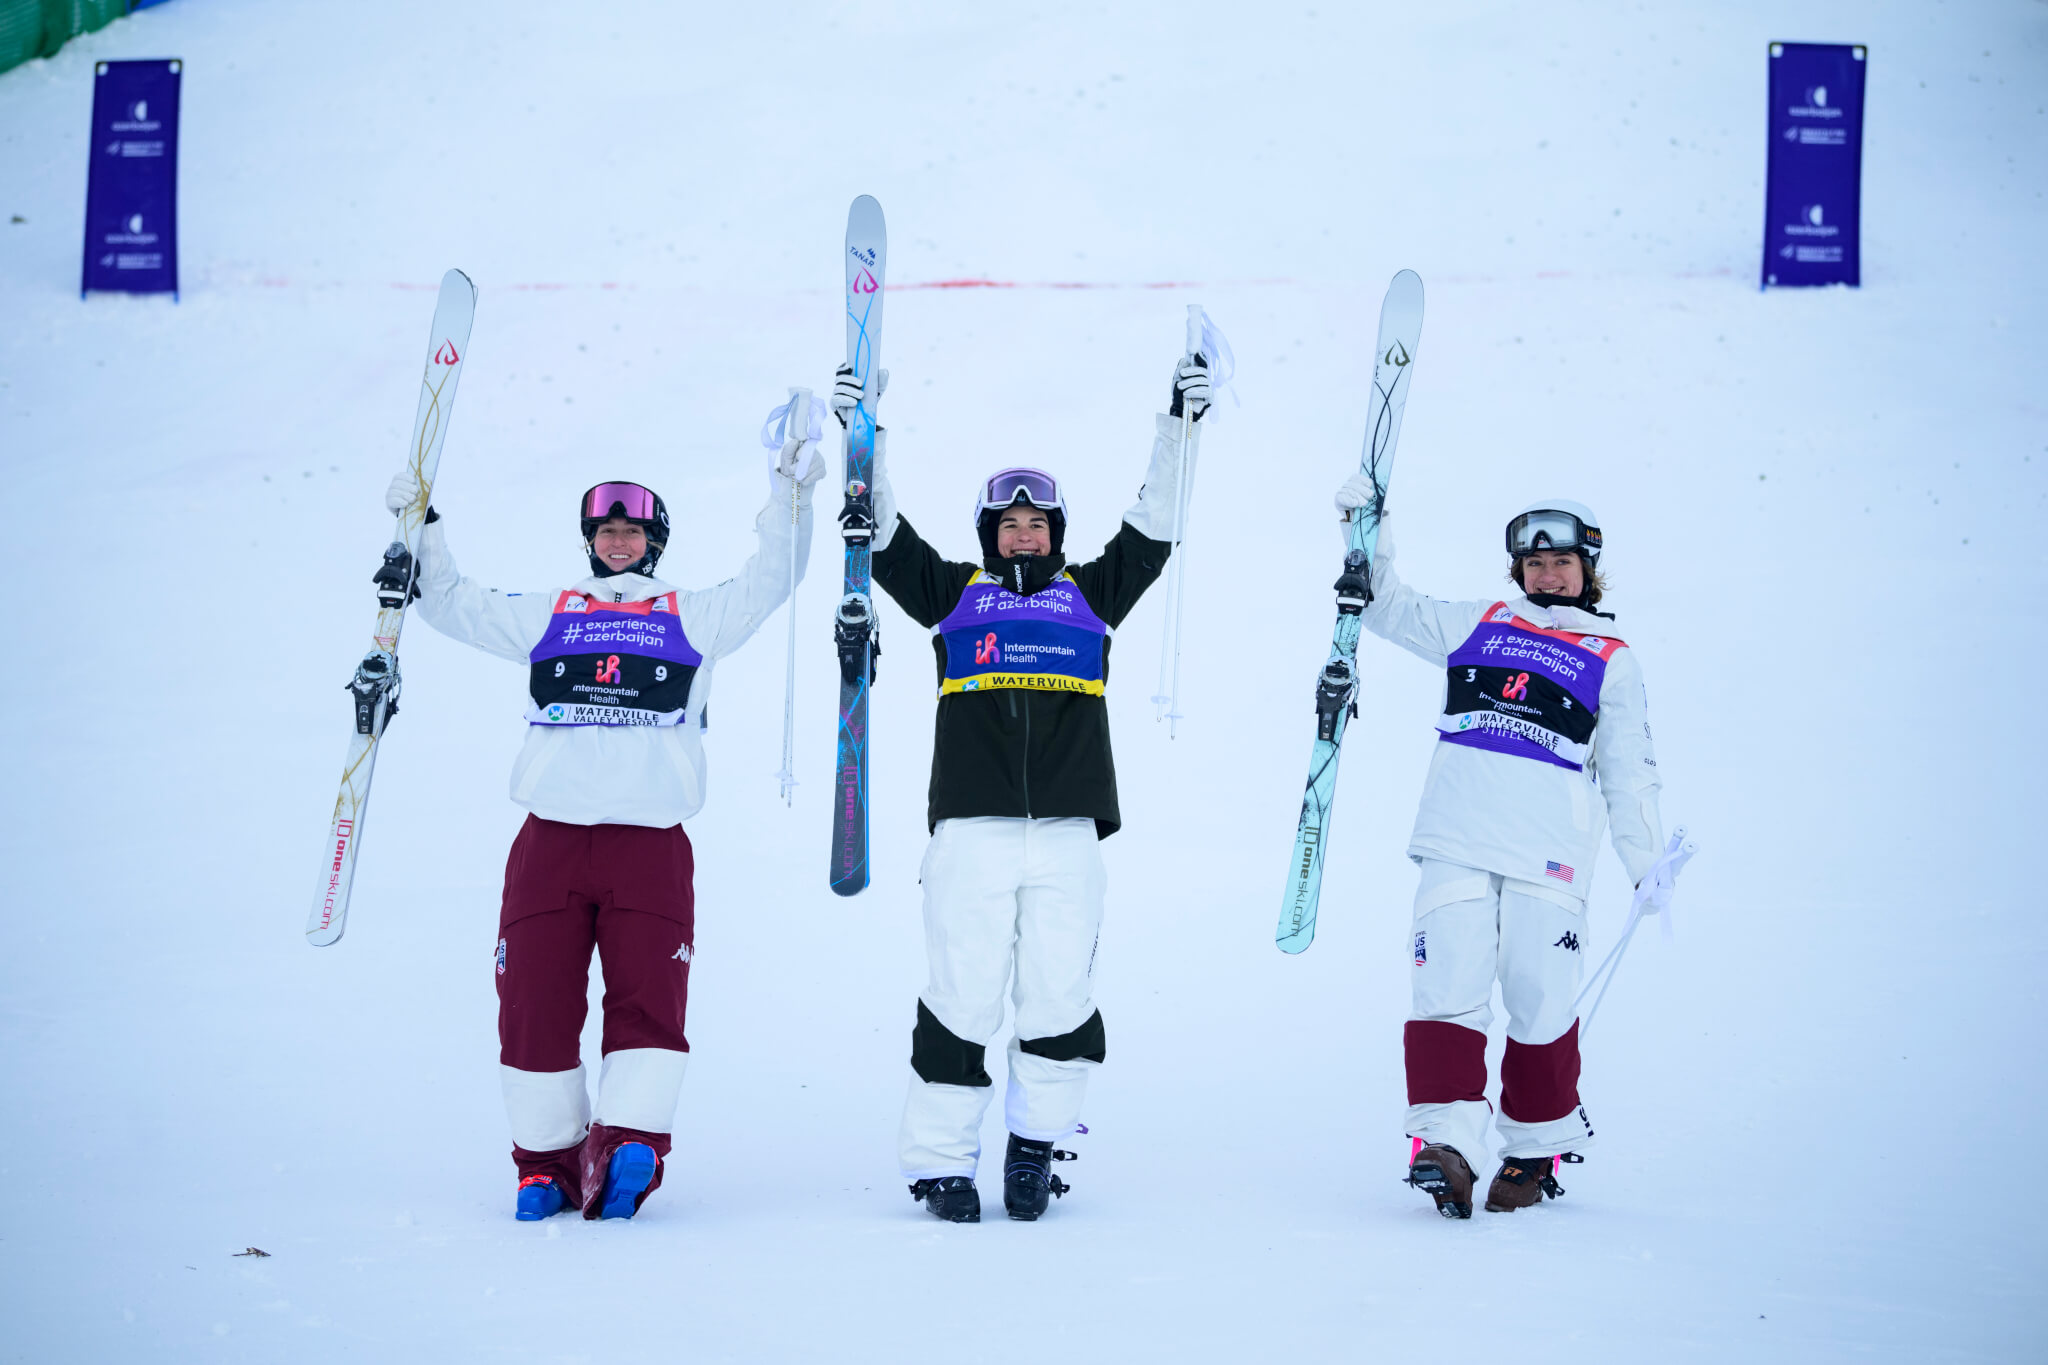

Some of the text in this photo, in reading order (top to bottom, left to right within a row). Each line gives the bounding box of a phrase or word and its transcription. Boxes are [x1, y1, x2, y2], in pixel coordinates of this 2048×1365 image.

[849, 246, 875, 267] TANAR
[1014, 564, 1023, 592] KARBON
[999, 588, 1073, 605] exprience
[998, 597, 1072, 615] azerbaijan
[586, 618, 666, 634] experience
[584, 631, 664, 647] azerbaijan
[1004, 642, 1075, 656] Intermountain
[1506, 635, 1585, 671] experience
[1004, 653, 1037, 663] Health
[1501, 646, 1578, 681] azerbaijan
[554, 662, 566, 677] 9
[655, 666, 668, 681] 9
[1465, 668, 1477, 683] 3
[992, 676, 1086, 691] WATERVILLE
[589, 694, 619, 704] Health
[574, 715, 659, 727] VALLEY RESORT
[575, 706, 660, 721] WATERVILLE
[1479, 712, 1560, 745] WATERVILLE
